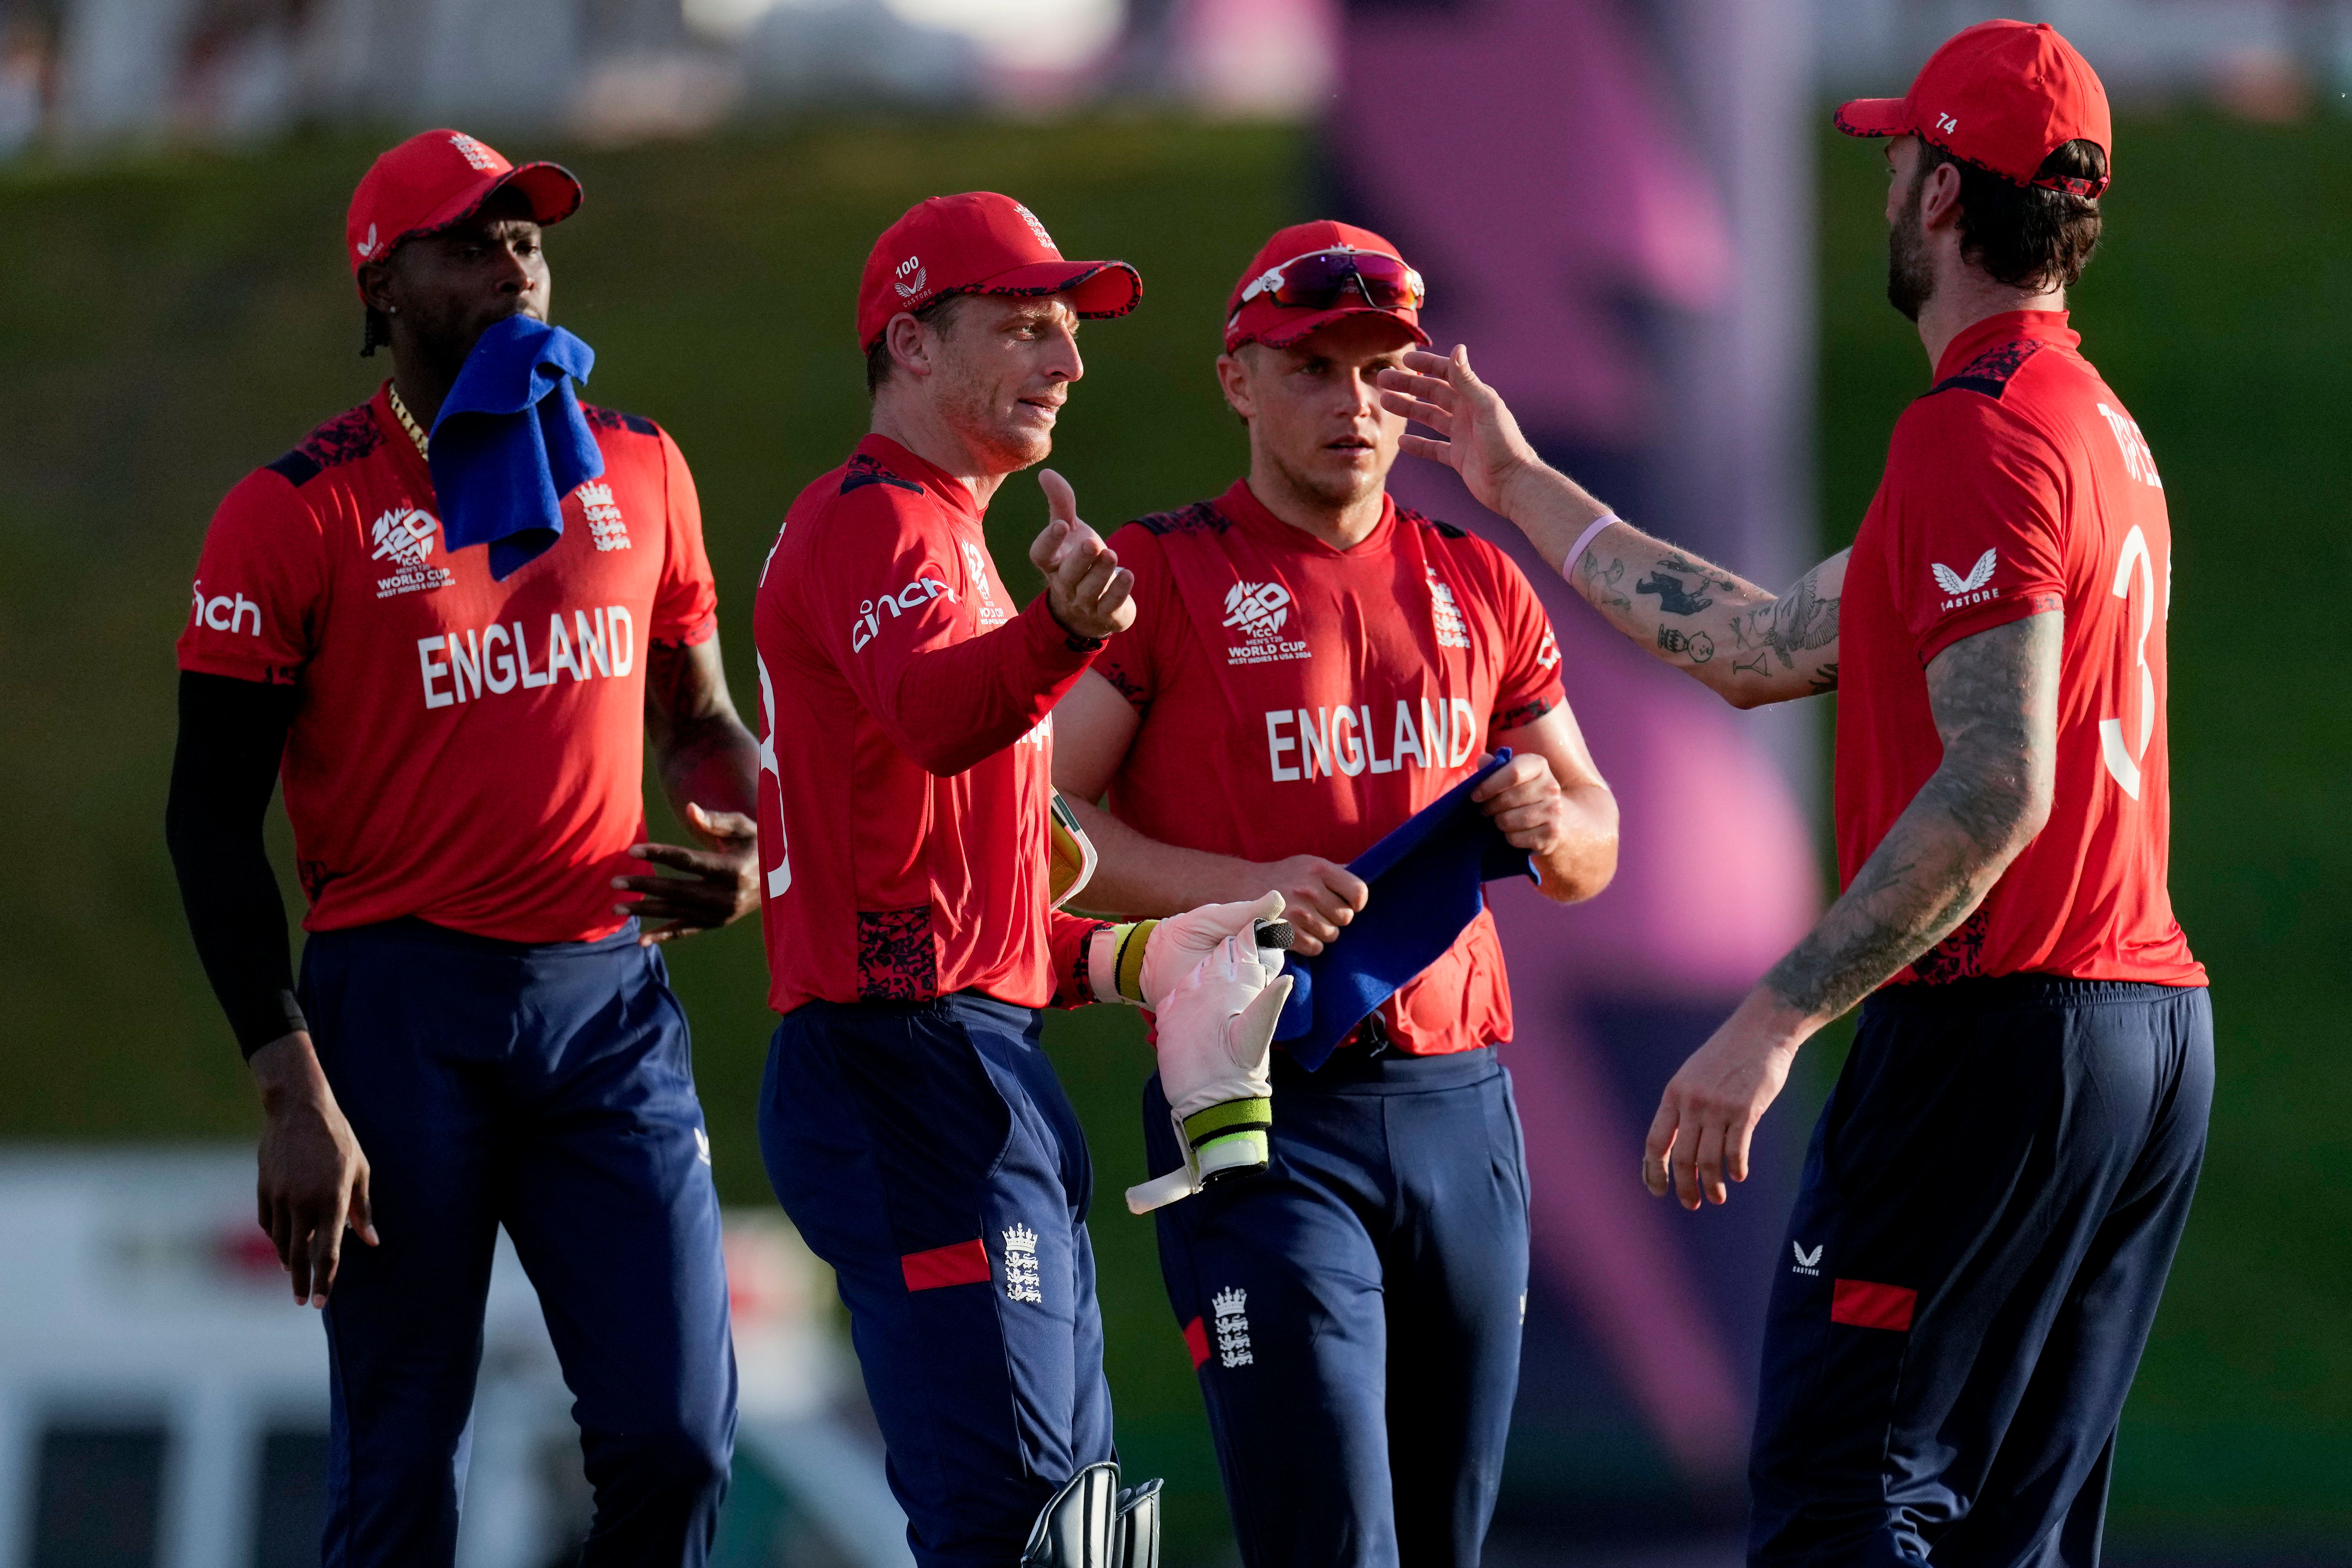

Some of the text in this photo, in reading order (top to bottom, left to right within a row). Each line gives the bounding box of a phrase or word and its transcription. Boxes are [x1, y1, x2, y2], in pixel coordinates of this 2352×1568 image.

[1936, 113, 1957, 134] 74
[896, 256, 919, 279] 100
[903, 289, 932, 307] CASTORE
[402, 555, 421, 567] ICC
[377, 568, 451, 591] WORLD CUP
[396, 565, 417, 576] MEN'S
[376, 588, 396, 599] WEST
[397, 583, 420, 594] INDIES
[427, 580, 440, 589] USA
[852, 577, 956, 653] cinch
[1245, 635, 1284, 647] MEN'S T20
[1252, 628, 1273, 638] ICC
[418, 605, 634, 710] ENGLAND
[1228, 641, 1307, 658] WORLD CUP
[1227, 657, 1247, 666] WEST
[1247, 655, 1273, 664] INDIES
[1279, 652, 1294, 661] USA
[1266, 697, 1477, 782] ENGLAND
